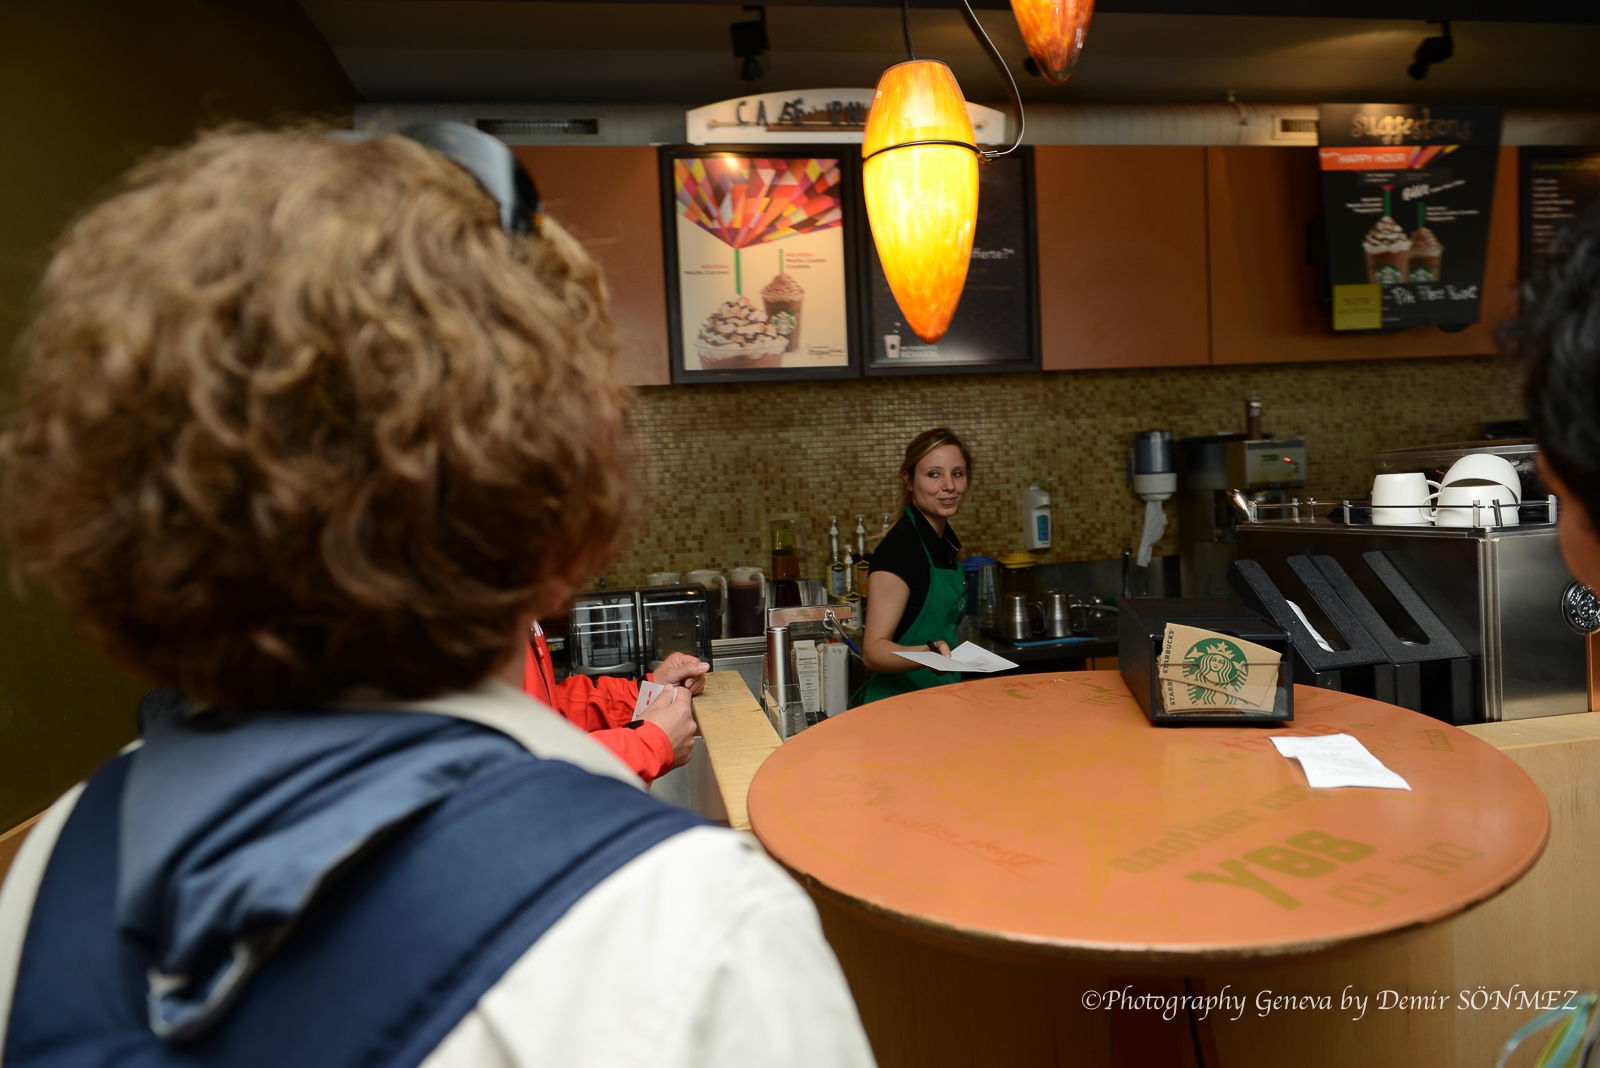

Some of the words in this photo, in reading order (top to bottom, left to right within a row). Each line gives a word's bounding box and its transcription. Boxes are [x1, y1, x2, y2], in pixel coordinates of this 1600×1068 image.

[1375, 151, 1407, 163] HOUR
[1162, 629, 1175, 674] STARBUCKS
[1167, 680, 1177, 706] STARB
